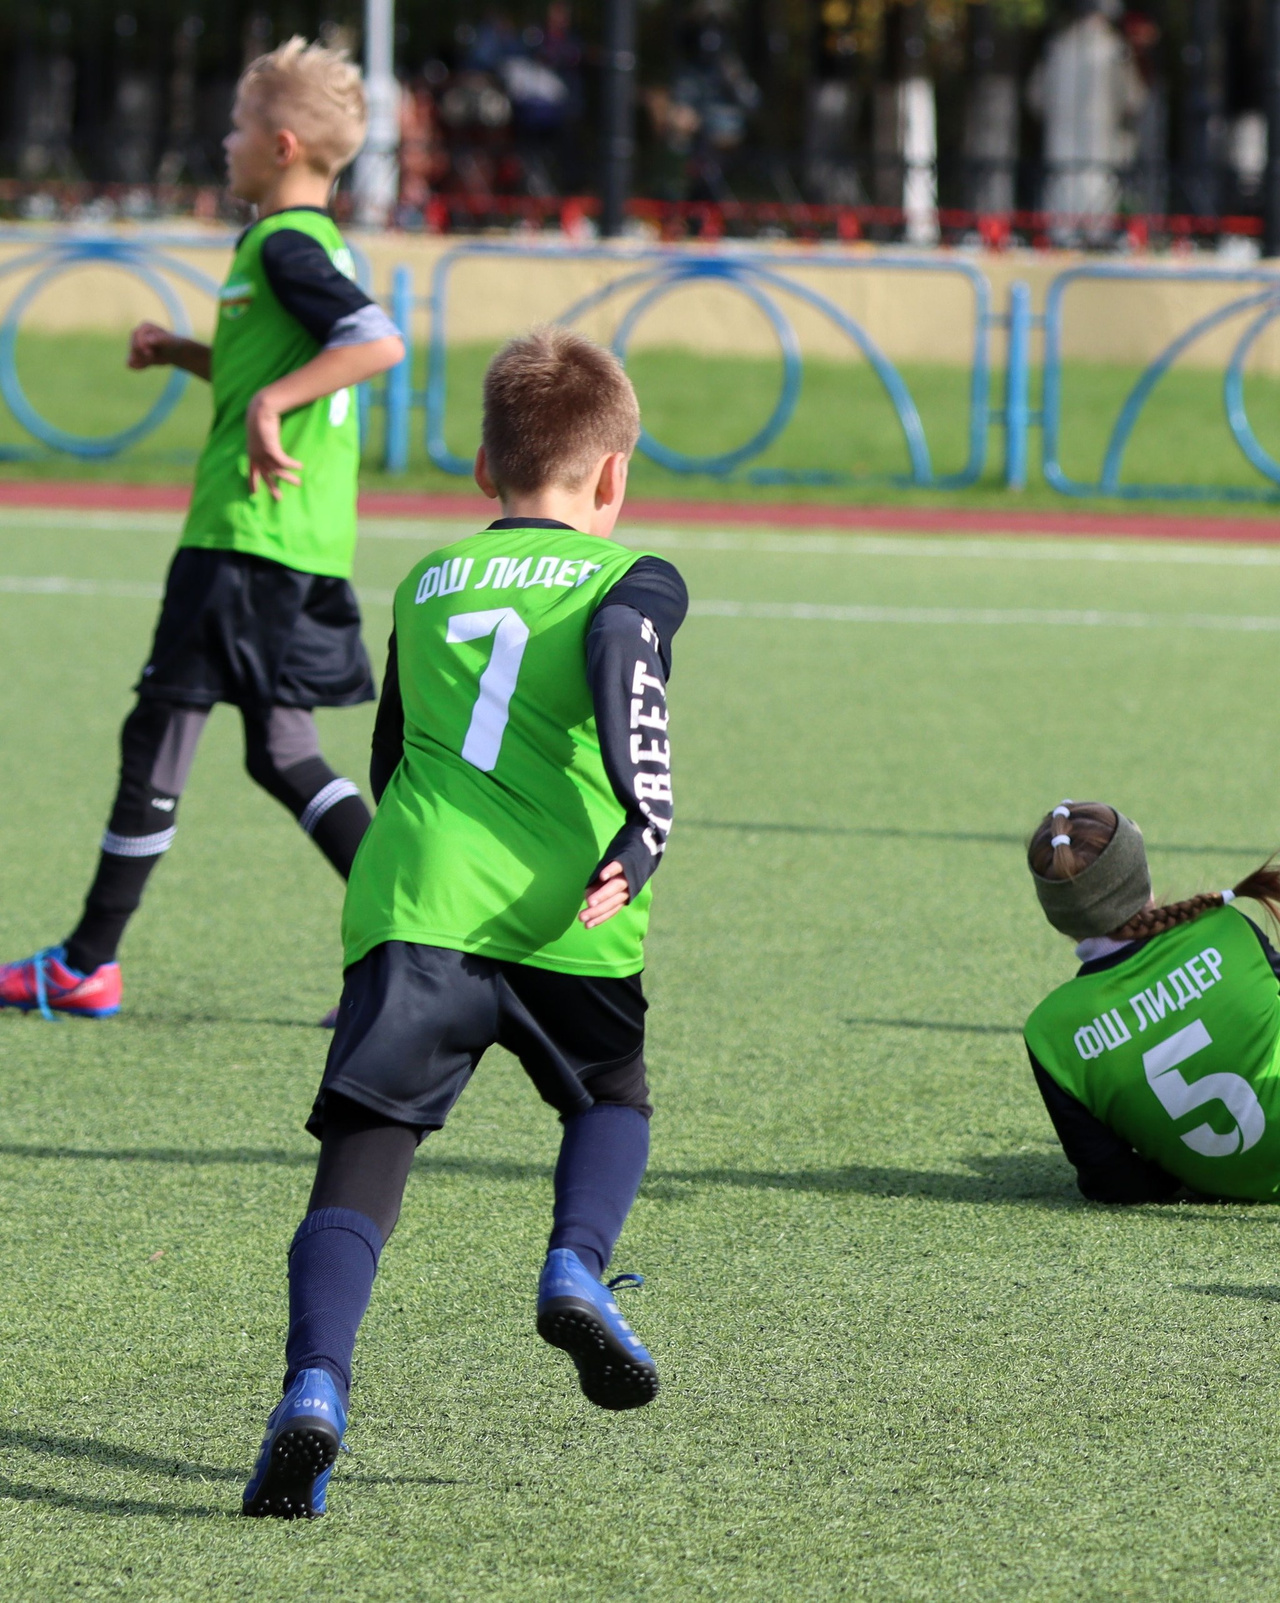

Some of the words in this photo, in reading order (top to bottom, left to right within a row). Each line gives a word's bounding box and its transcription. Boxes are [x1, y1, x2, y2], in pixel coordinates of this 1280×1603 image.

[414, 557, 475, 605] ФШ
[474, 556, 603, 590] ЛИДЕР
[446, 606, 530, 772] 7
[1073, 1008, 1132, 1060] ФШ
[1129, 947, 1223, 1032] ЛИДЕР
[1142, 1018, 1266, 1157] 5
[294, 1398, 329, 1411] COPA
